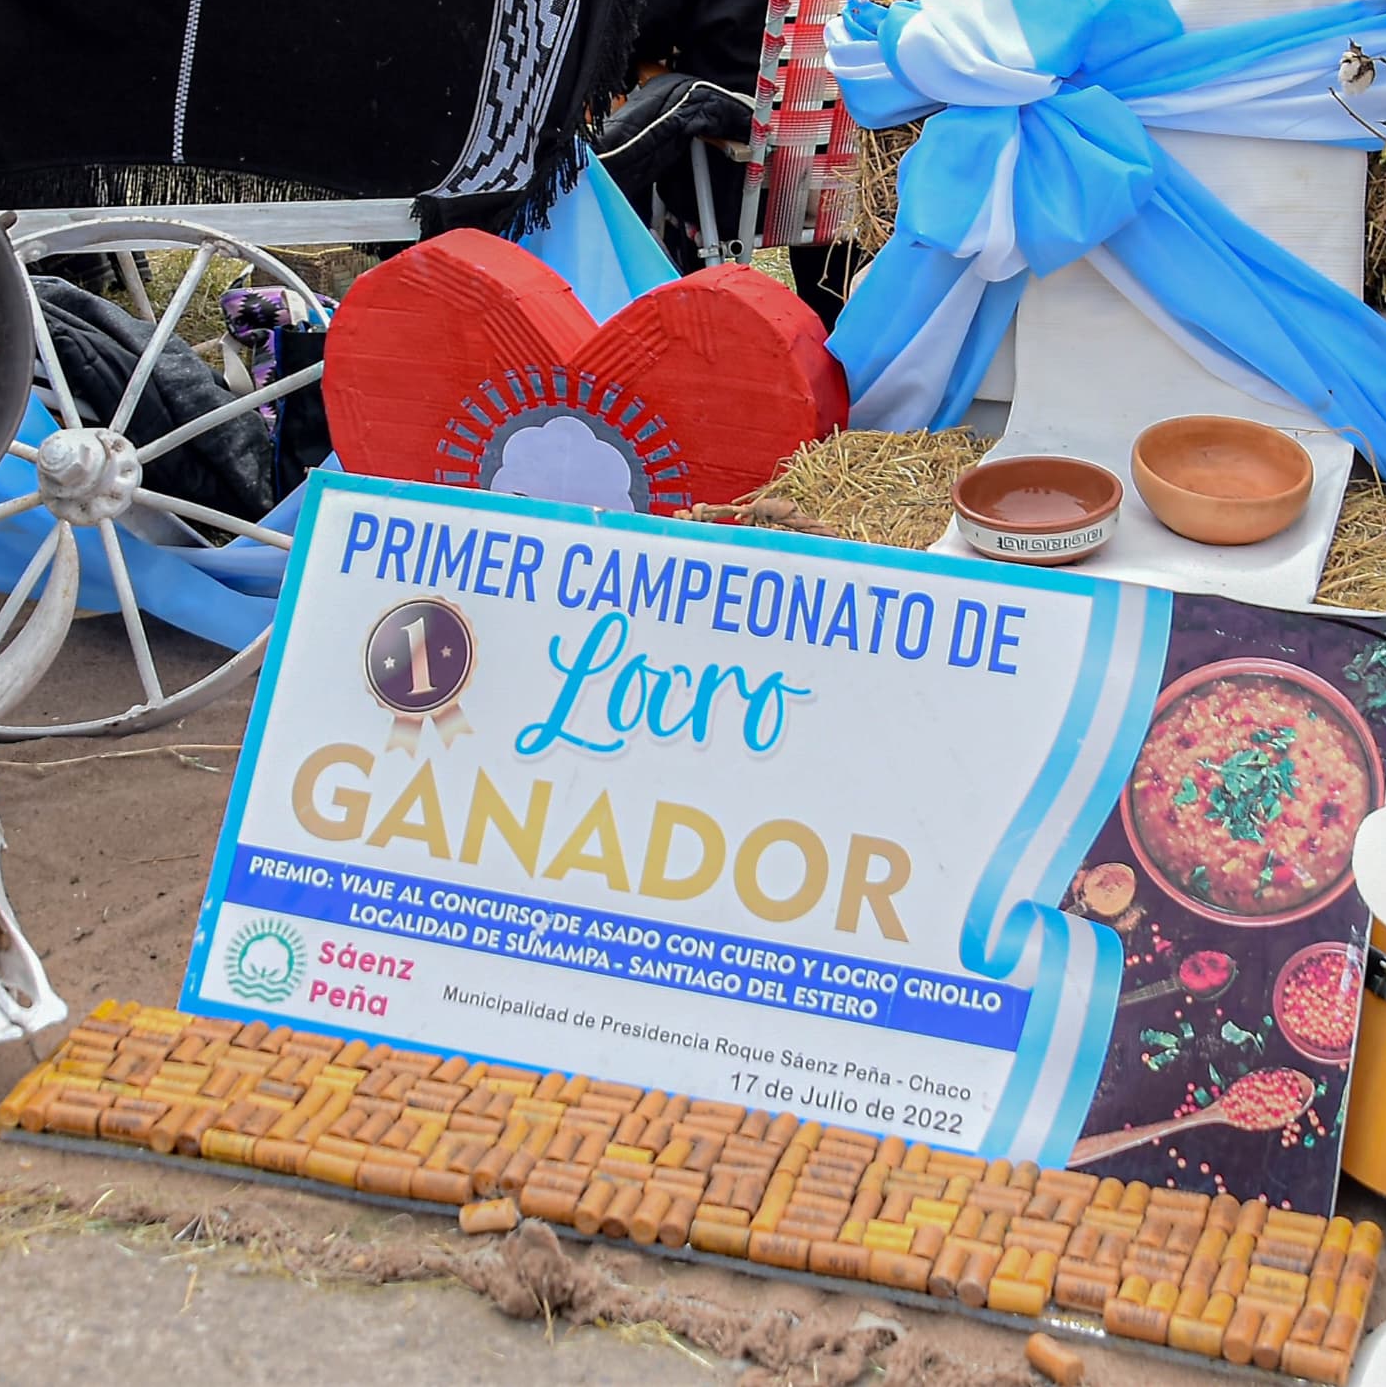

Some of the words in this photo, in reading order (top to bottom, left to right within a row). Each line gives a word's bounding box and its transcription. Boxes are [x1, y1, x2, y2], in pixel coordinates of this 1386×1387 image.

[340, 512, 545, 602] PRIMER
[556, 542, 935, 661] CAMPEONATO
[948, 598, 1026, 675] DE
[400, 616, 438, 696] 1
[514, 611, 812, 755] Locro
[291, 742, 911, 943] GANADOR
[249, 855, 335, 889] PREMIO:
[340, 872, 396, 901] VIAJE
[398, 884, 424, 907] AL
[429, 890, 548, 928] CONCURSO
[552, 913, 581, 939] DE
[585, 917, 661, 950] ASADO
[666, 933, 714, 960] CON
[720, 942, 796, 975] CUERO
[801, 958, 819, 978] Y
[821, 962, 899, 994] LOCRO
[903, 976, 1003, 1013] CRIOLLO
[317, 940, 416, 980] Sáenz
[349, 902, 468, 942] LOCALIDAD
[472, 928, 500, 949] DE
[505, 932, 612, 970] SUMAMPA
[627, 954, 742, 994] SANTIAGO
[746, 978, 788, 1003] DEL
[793, 986, 878, 1019] ESTERO
[308, 979, 389, 1017] Peña
[442, 984, 568, 1024] Municipalidad
[573, 1010, 596, 1029] de
[600, 1015, 710, 1051] Presidencia
[714, 1038, 775, 1064] Roque
[780, 1047, 838, 1075] Sáenz
[843, 1061, 893, 1087] Peña
[909, 1074, 972, 1101] Chaco
[730, 1071, 759, 1095] 17
[764, 1077, 794, 1102] de
[800, 1085, 859, 1114] Julio
[865, 1097, 895, 1122] de
[902, 1105, 964, 1136] 2022
